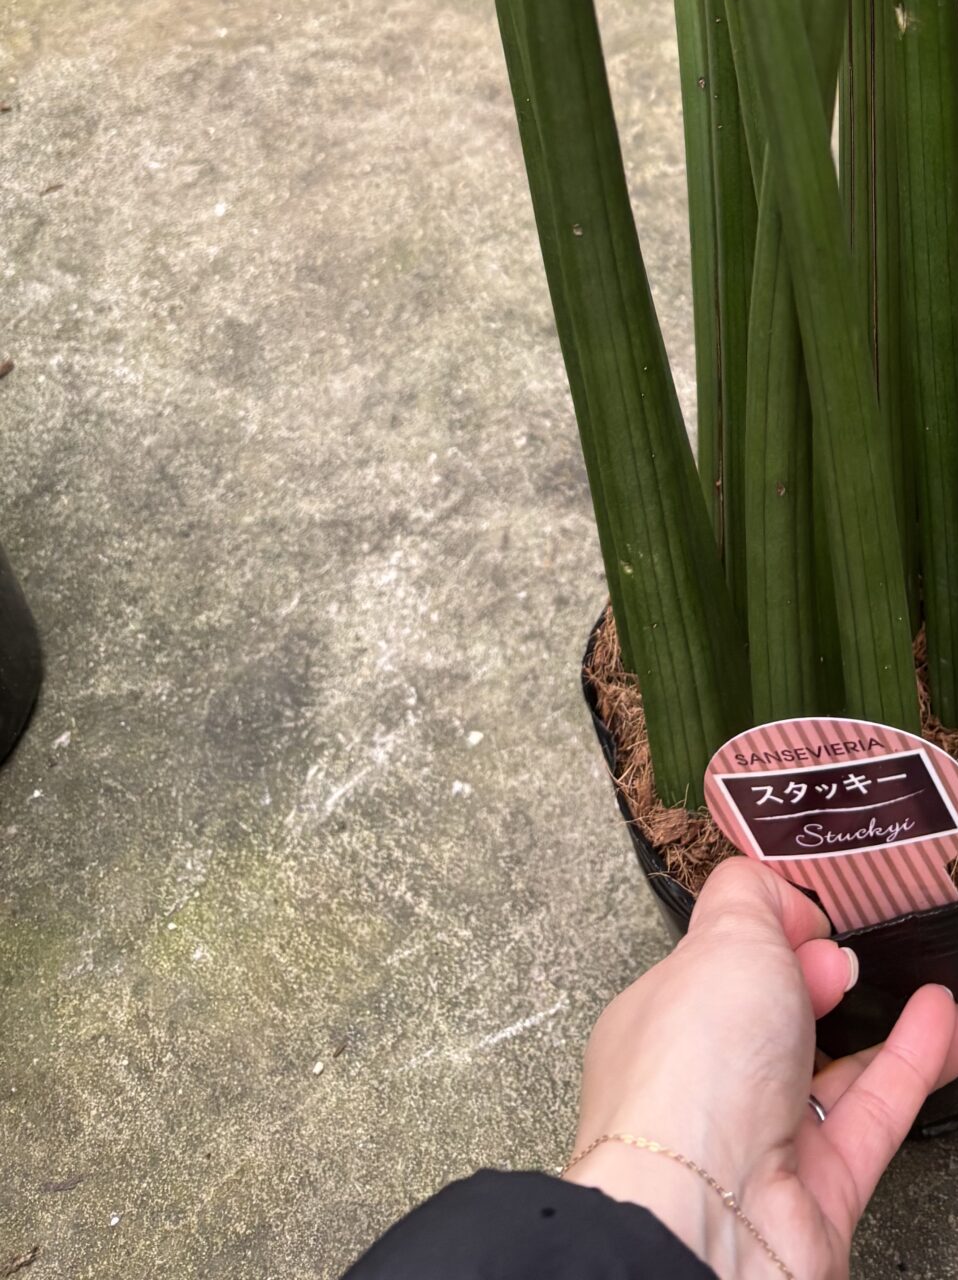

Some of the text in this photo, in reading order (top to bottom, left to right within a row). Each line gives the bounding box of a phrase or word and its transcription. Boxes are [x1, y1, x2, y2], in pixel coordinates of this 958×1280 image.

[735, 737, 885, 766] SANSEVIERIA
[751, 773, 907, 806] スタッキー
[795, 817, 916, 847] Stuckyi
